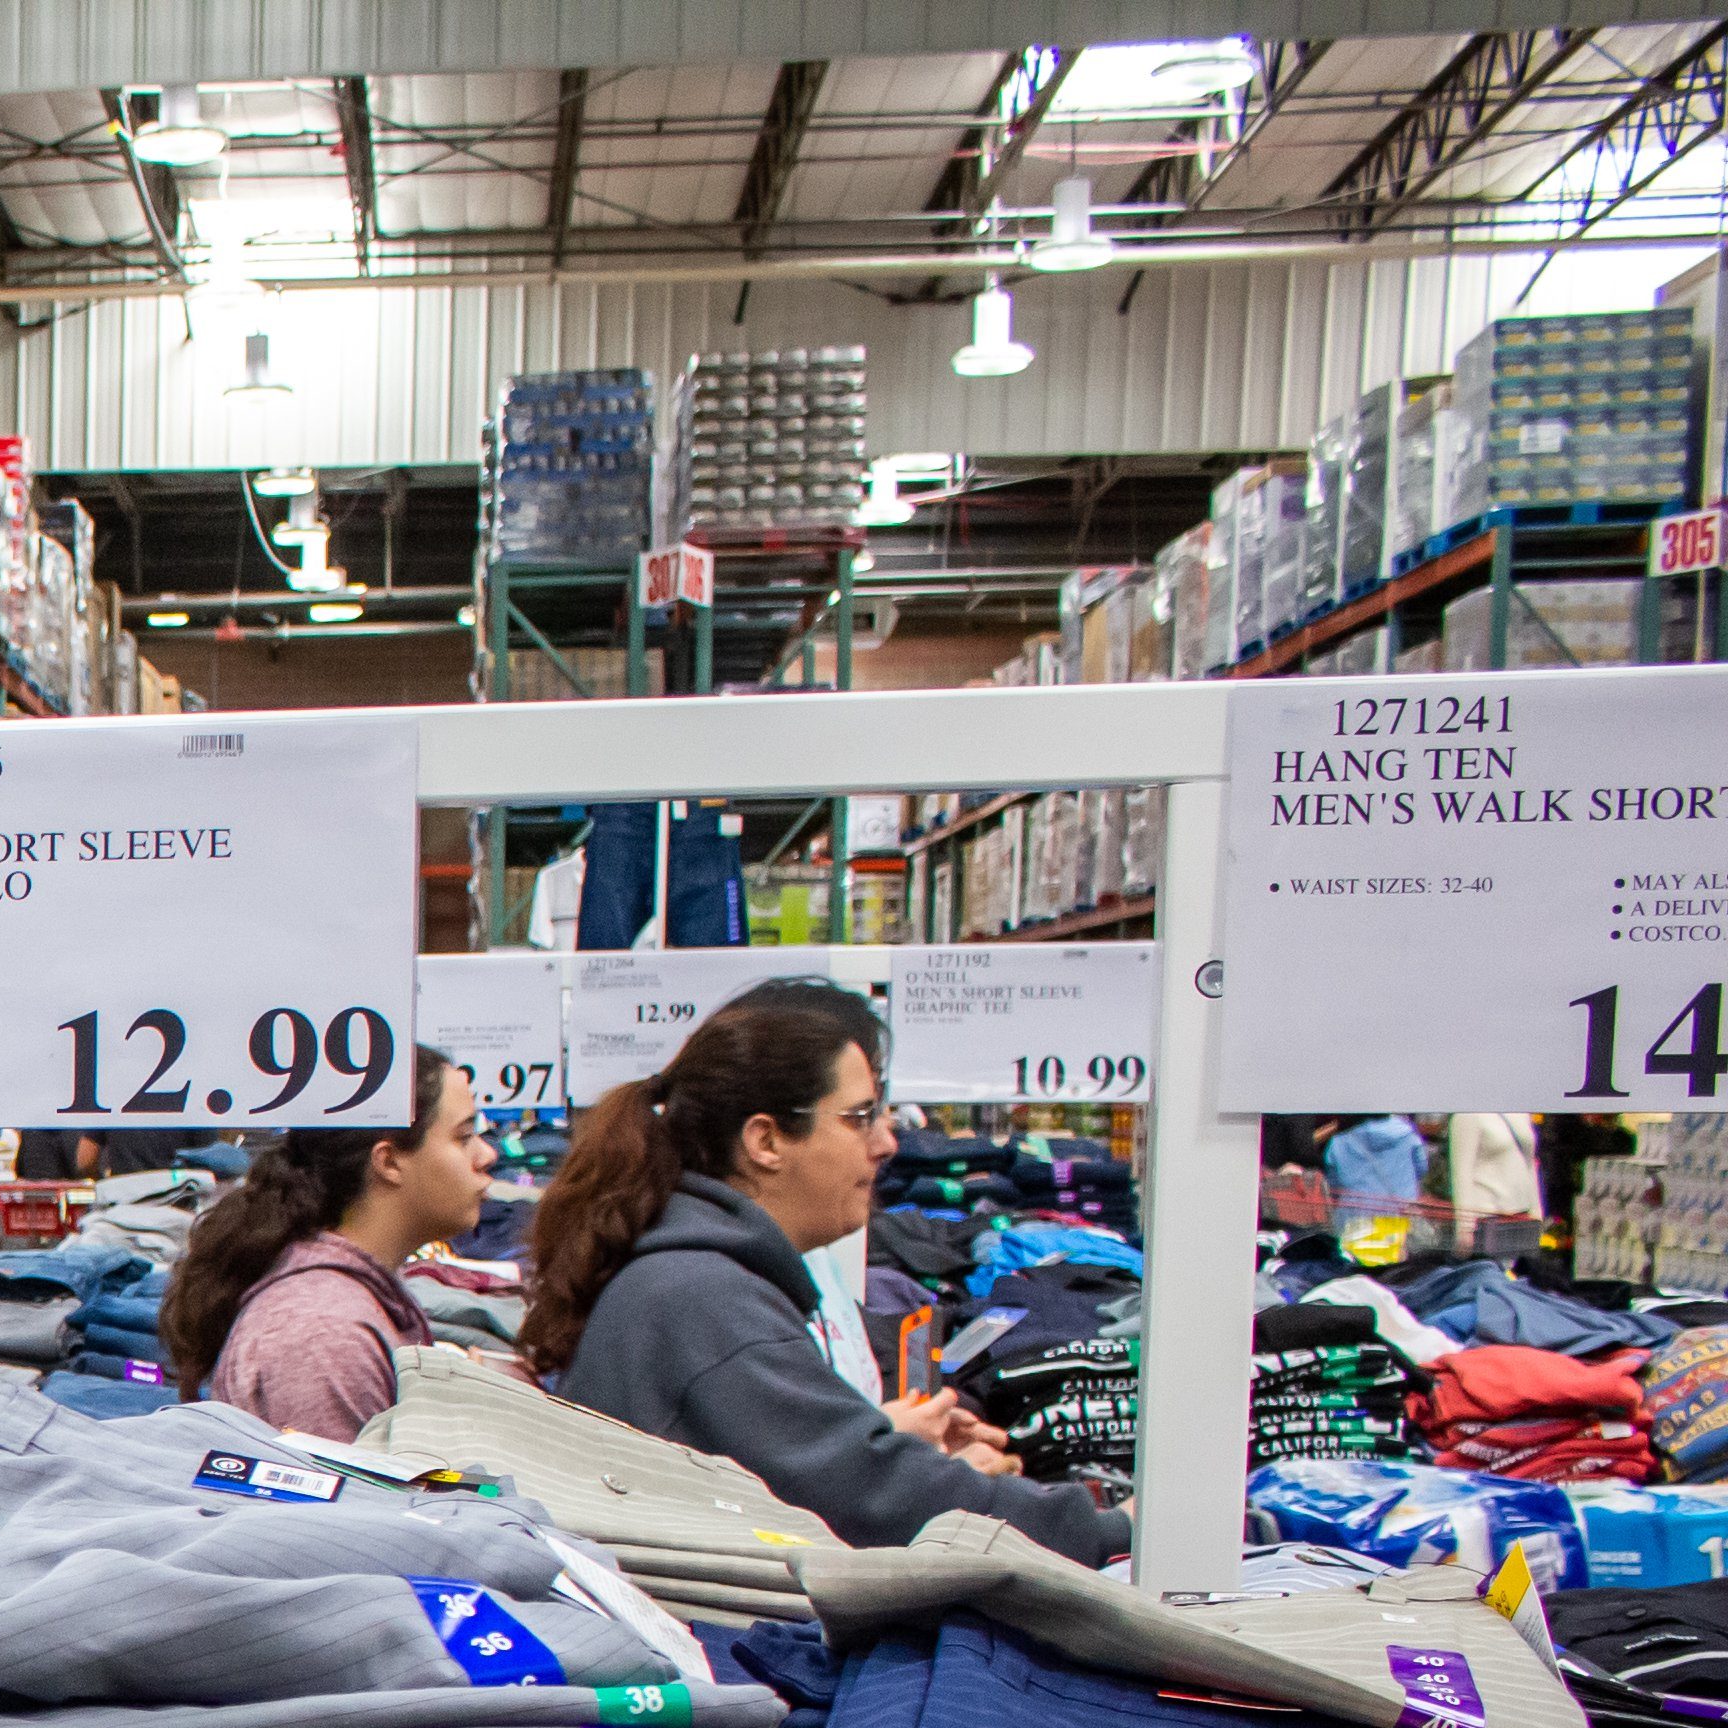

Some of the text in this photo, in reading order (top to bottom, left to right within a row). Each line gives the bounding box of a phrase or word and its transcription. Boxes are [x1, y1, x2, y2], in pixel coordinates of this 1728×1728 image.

[1661, 515, 1716, 571] 305
[1333, 696, 1513, 736] 1271241
[1273, 747, 1518, 783] HANG TEN
[1271, 792, 1415, 826] MEN'S
[1432, 790, 1573, 824] WALK
[78, 828, 232, 862] SLEEVE
[1290, 876, 1493, 895] WAIST SIZES: 32-40
[1632, 874, 1686, 891] MAY
[1631, 899, 1728, 916] A DELIV
[927, 953, 991, 968] 1271192
[905, 985, 1083, 999] MEN'S SHORT SLEEVE
[636, 1003, 696, 1024] 12.99
[904, 1000, 1014, 1014] GRAPHIC TEE
[56, 1006, 395, 1115] 12.99
[1011, 1055, 1147, 1098] 10.99
[1051, 1419, 1137, 1441] CALIFOR
[1257, 1437, 1340, 1457] CALIFOR
[470, 1631, 514, 1657] 36
[1413, 1655, 1446, 1668] 40
[1417, 1673, 1450, 1685] 40
[625, 1685, 665, 1715] 38
